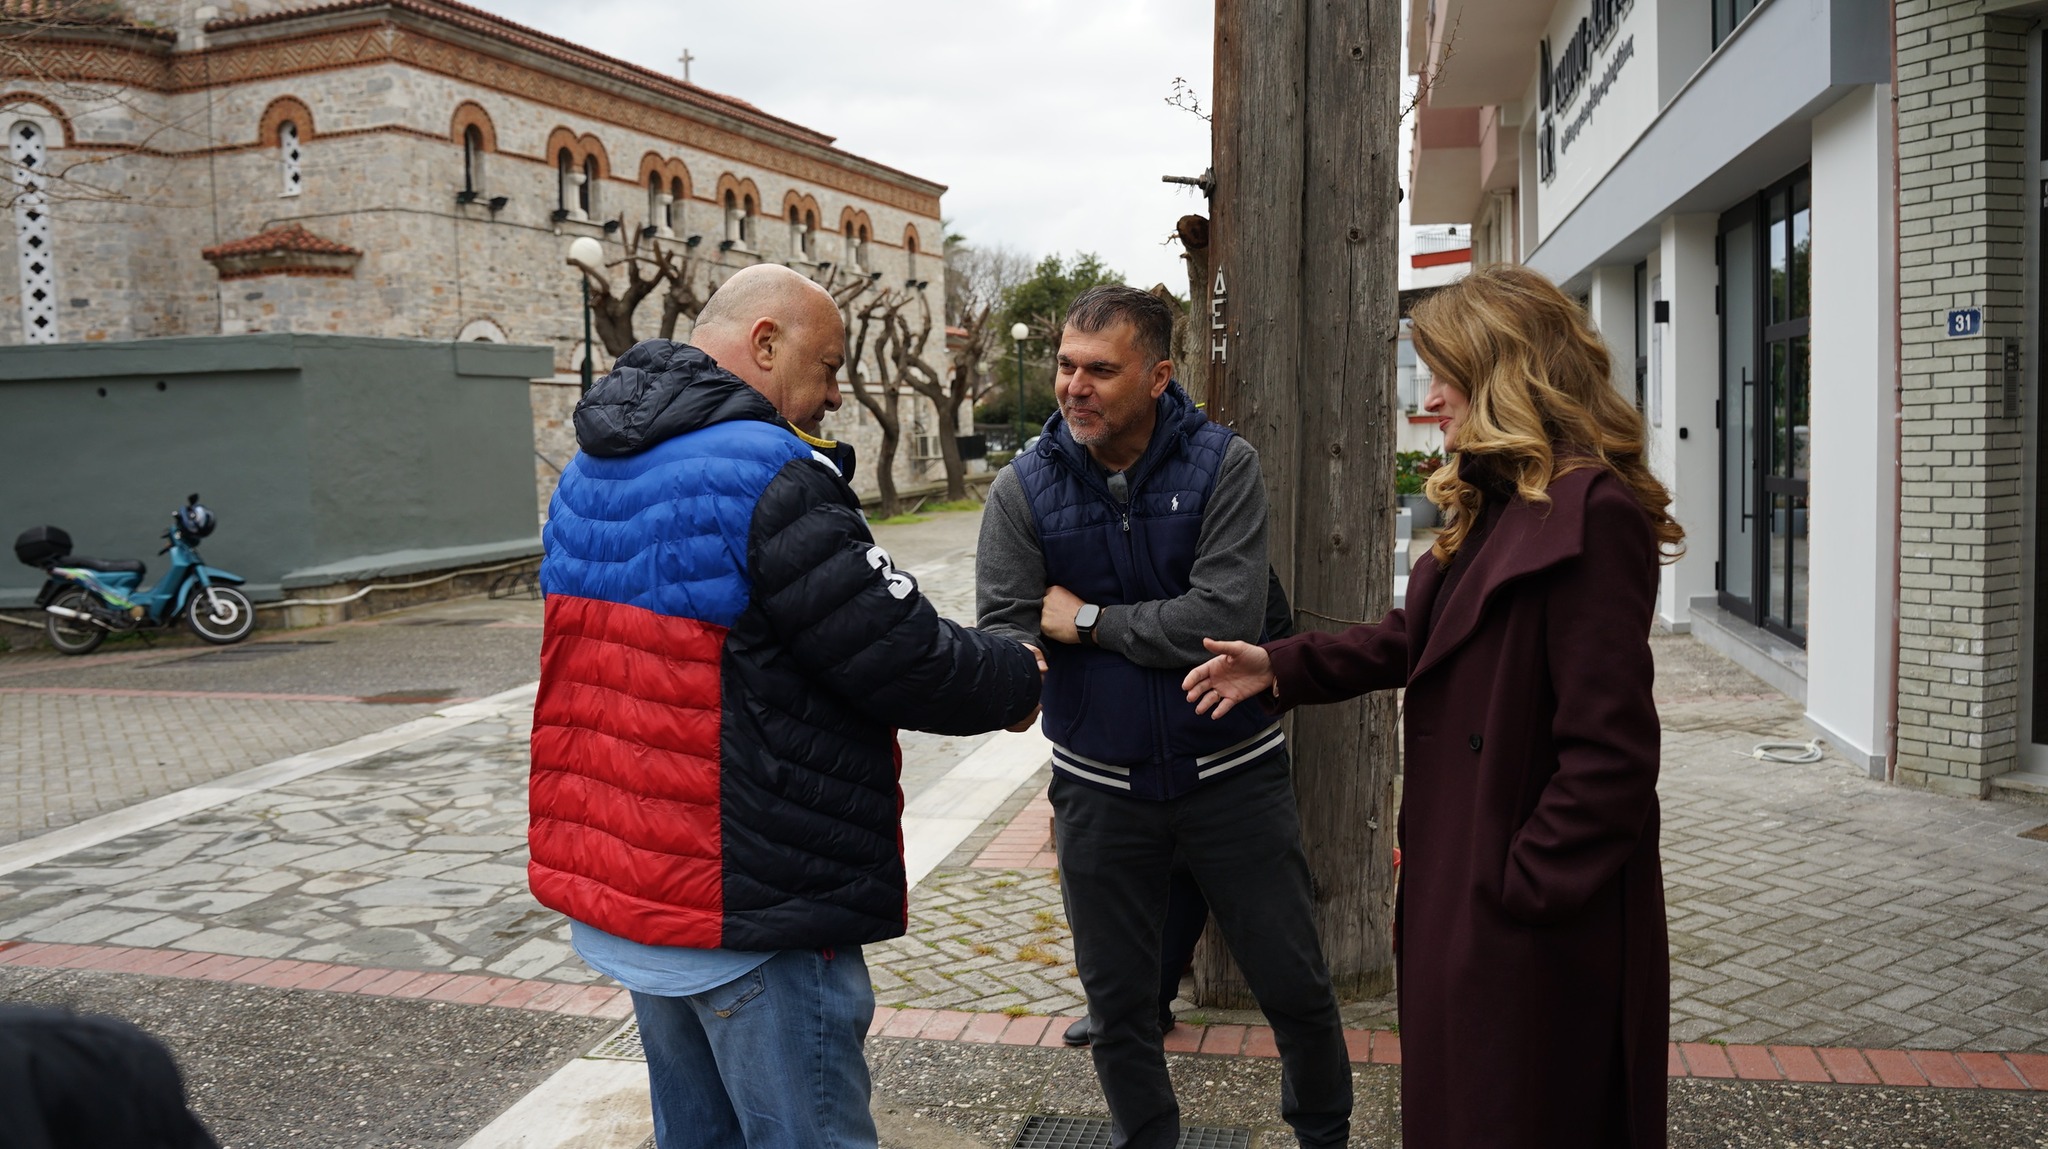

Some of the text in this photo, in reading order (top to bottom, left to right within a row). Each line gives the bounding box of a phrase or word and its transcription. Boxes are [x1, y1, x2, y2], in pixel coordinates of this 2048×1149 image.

[1211, 265, 1227, 364] ΔΕΗ
[1955, 313, 1971, 332] 31
[866, 545, 914, 600] 3
